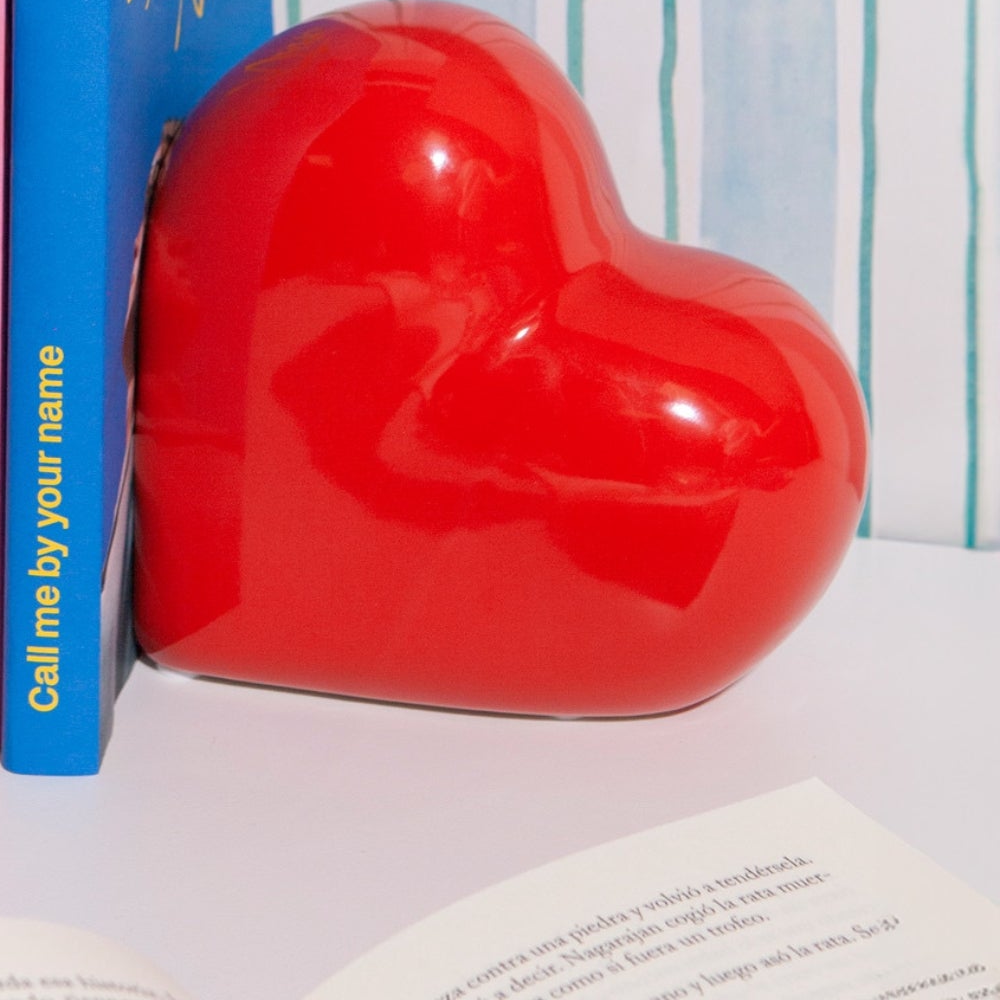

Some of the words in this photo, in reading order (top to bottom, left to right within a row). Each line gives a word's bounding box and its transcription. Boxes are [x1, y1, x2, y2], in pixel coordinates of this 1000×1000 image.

[38, 345, 64, 444] name
[37, 450, 70, 530] your
[28, 536, 70, 578] by
[35, 585, 61, 638] me
[26, 646, 60, 713] Call
[713, 897, 739, 912] la
[738, 887, 776, 906] rata
[467, 953, 530, 990] contra
[529, 935, 568, 958] una
[567, 910, 629, 944] piedra
[630, 904, 645, 921] y
[643, 885, 702, 912] volvió
[549, 970, 605, 1000] como
[623, 942, 679, 967] fuera
[677, 931, 708, 949] un
[699, 962, 759, 988] luego
[787, 943, 814, 960] la
